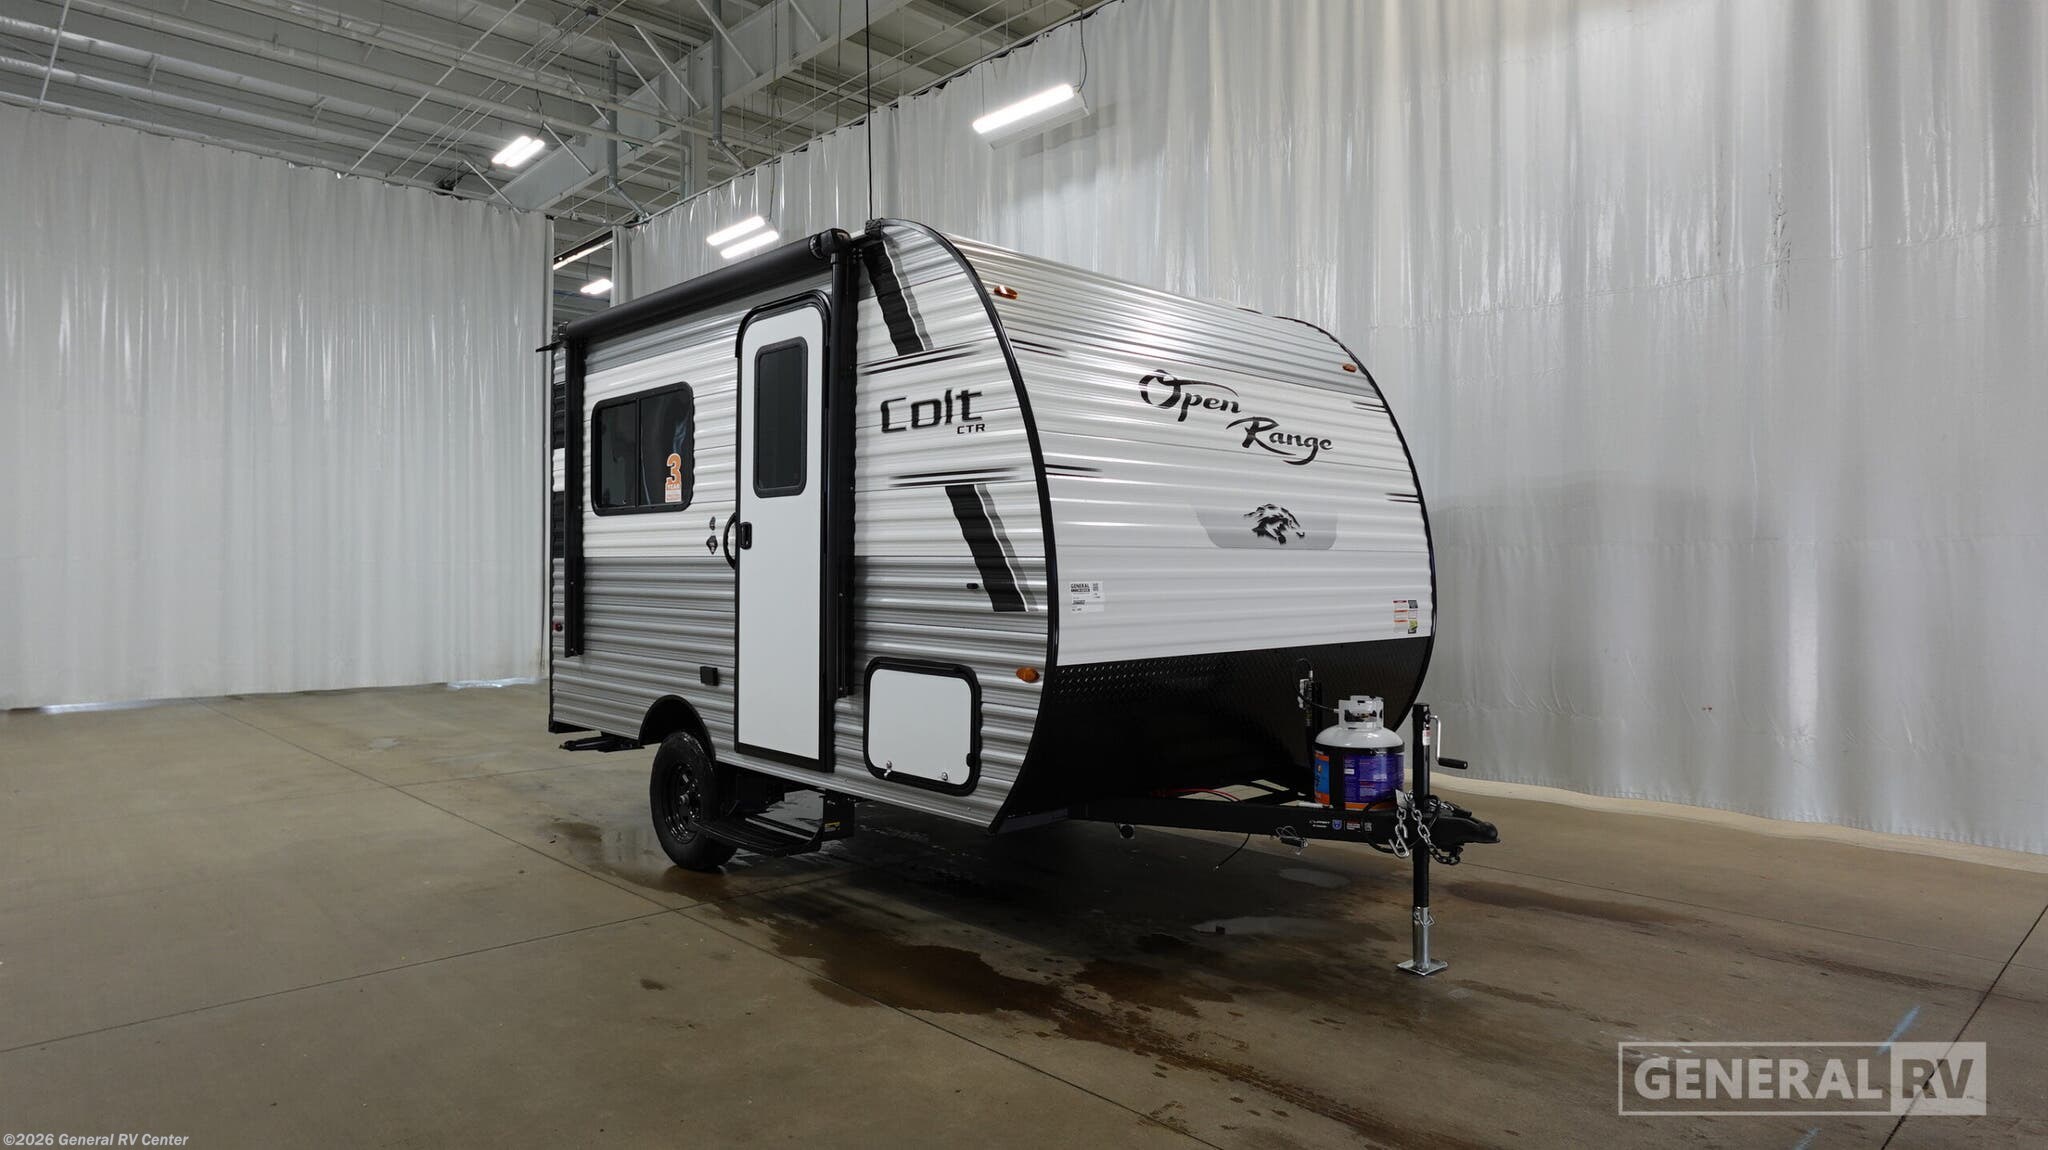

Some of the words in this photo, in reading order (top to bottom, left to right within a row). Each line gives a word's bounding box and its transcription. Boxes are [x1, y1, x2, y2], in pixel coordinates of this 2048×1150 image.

[881, 389, 983, 433] Colt
[1138, 369, 1242, 422] Open
[957, 423, 986, 435] CTR
[1226, 416, 1334, 466] Range
[666, 453, 681, 485] 3
